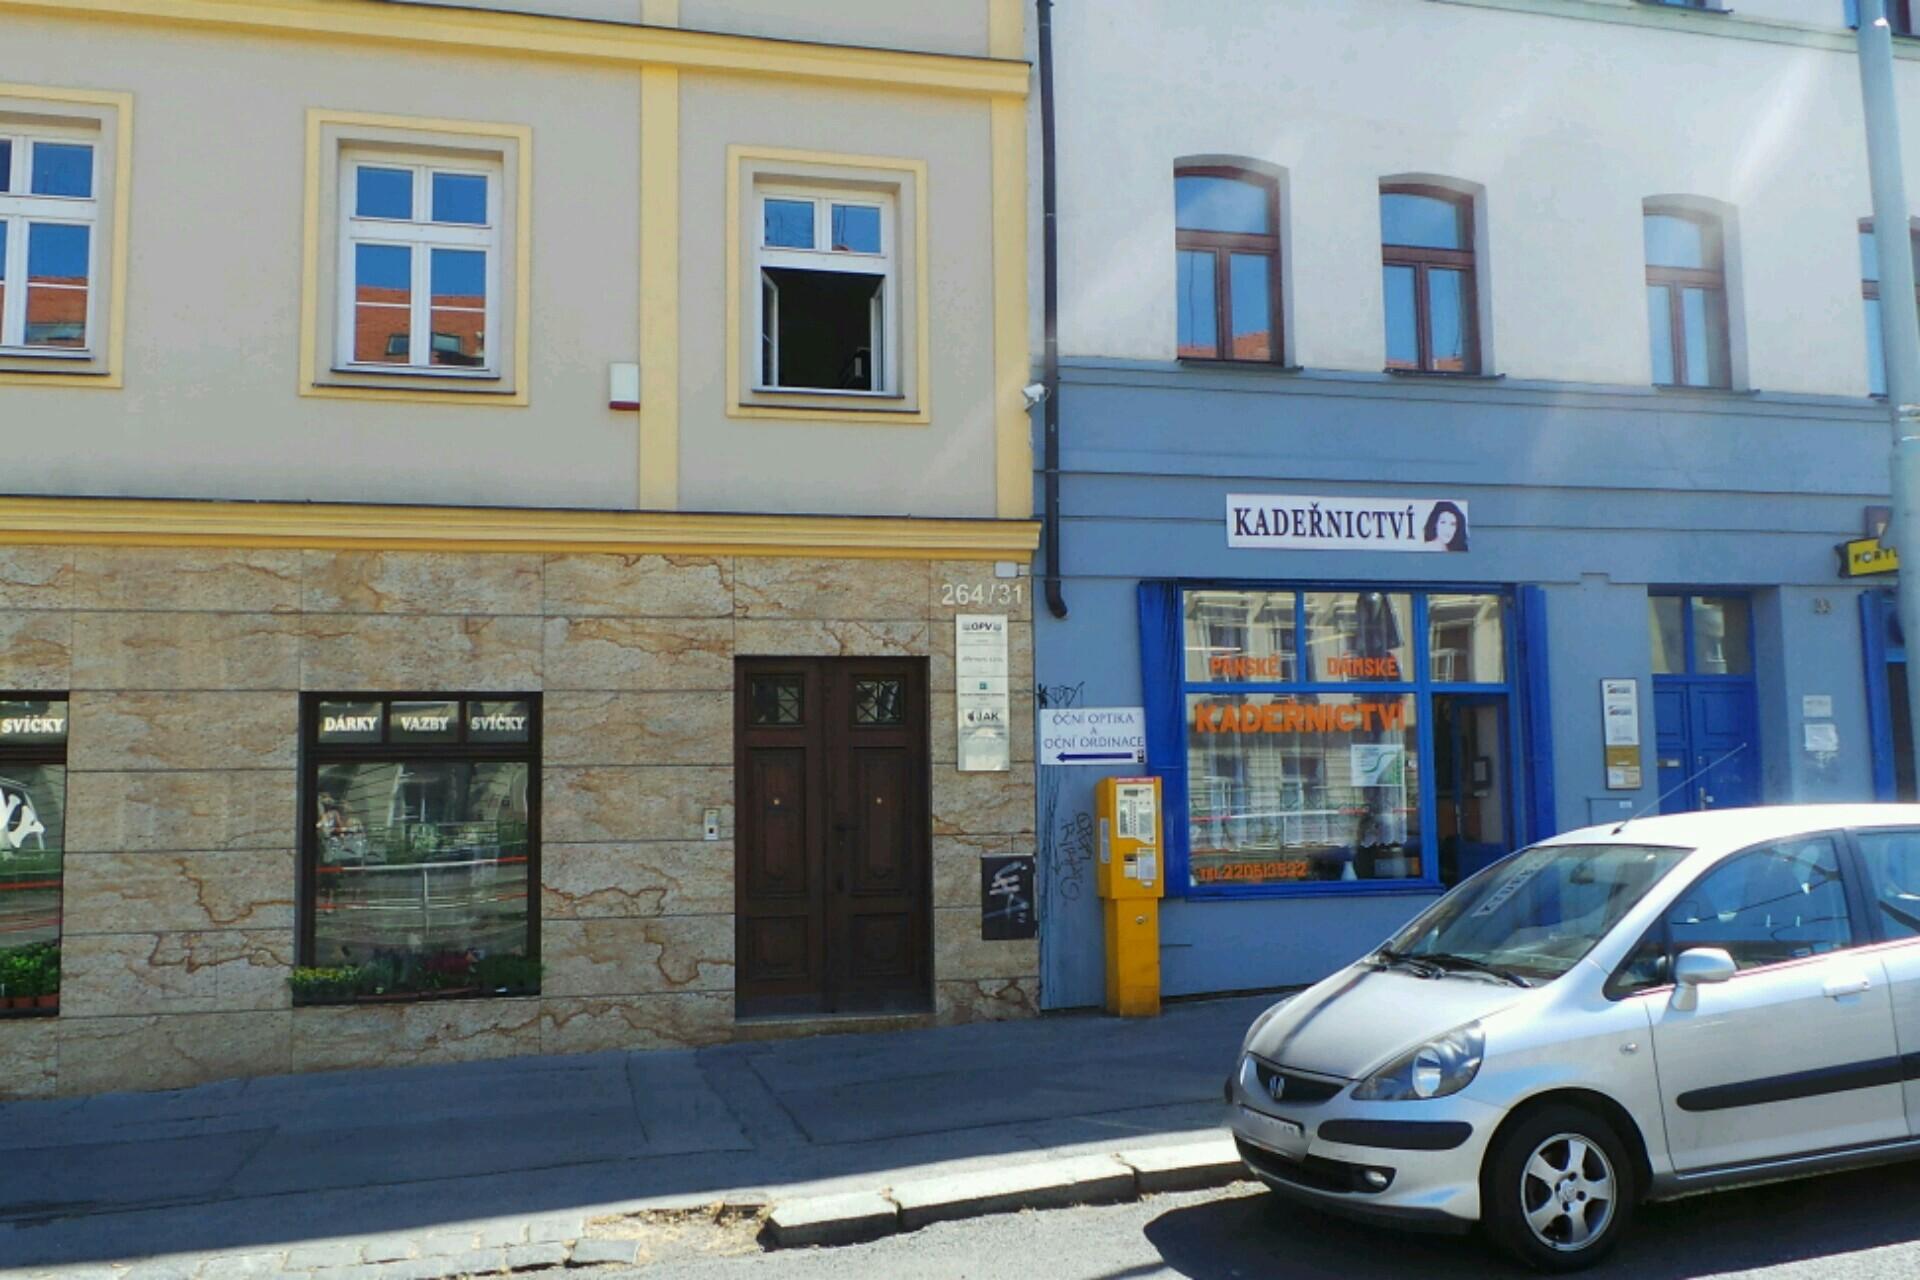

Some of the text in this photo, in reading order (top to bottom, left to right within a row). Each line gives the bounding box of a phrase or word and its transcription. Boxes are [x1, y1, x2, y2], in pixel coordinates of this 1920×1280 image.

[1234, 501, 1416, 540] KADEŘNICTVÍ
[942, 583, 1023, 606] 264/31
[1209, 653, 1281, 677] PÁNSKÉ
[1327, 653, 1399, 677] DÁMSKÉ
[1, 714, 64, 734] SVÍČKY
[324, 713, 525, 732] DÁRKY VAZBY SVÍČKY
[1088, 712, 1134, 724] OPTIKA
[1195, 698, 1407, 733] KADEŘNICTVÍ
[1080, 736, 1145, 749] ORDINACE
